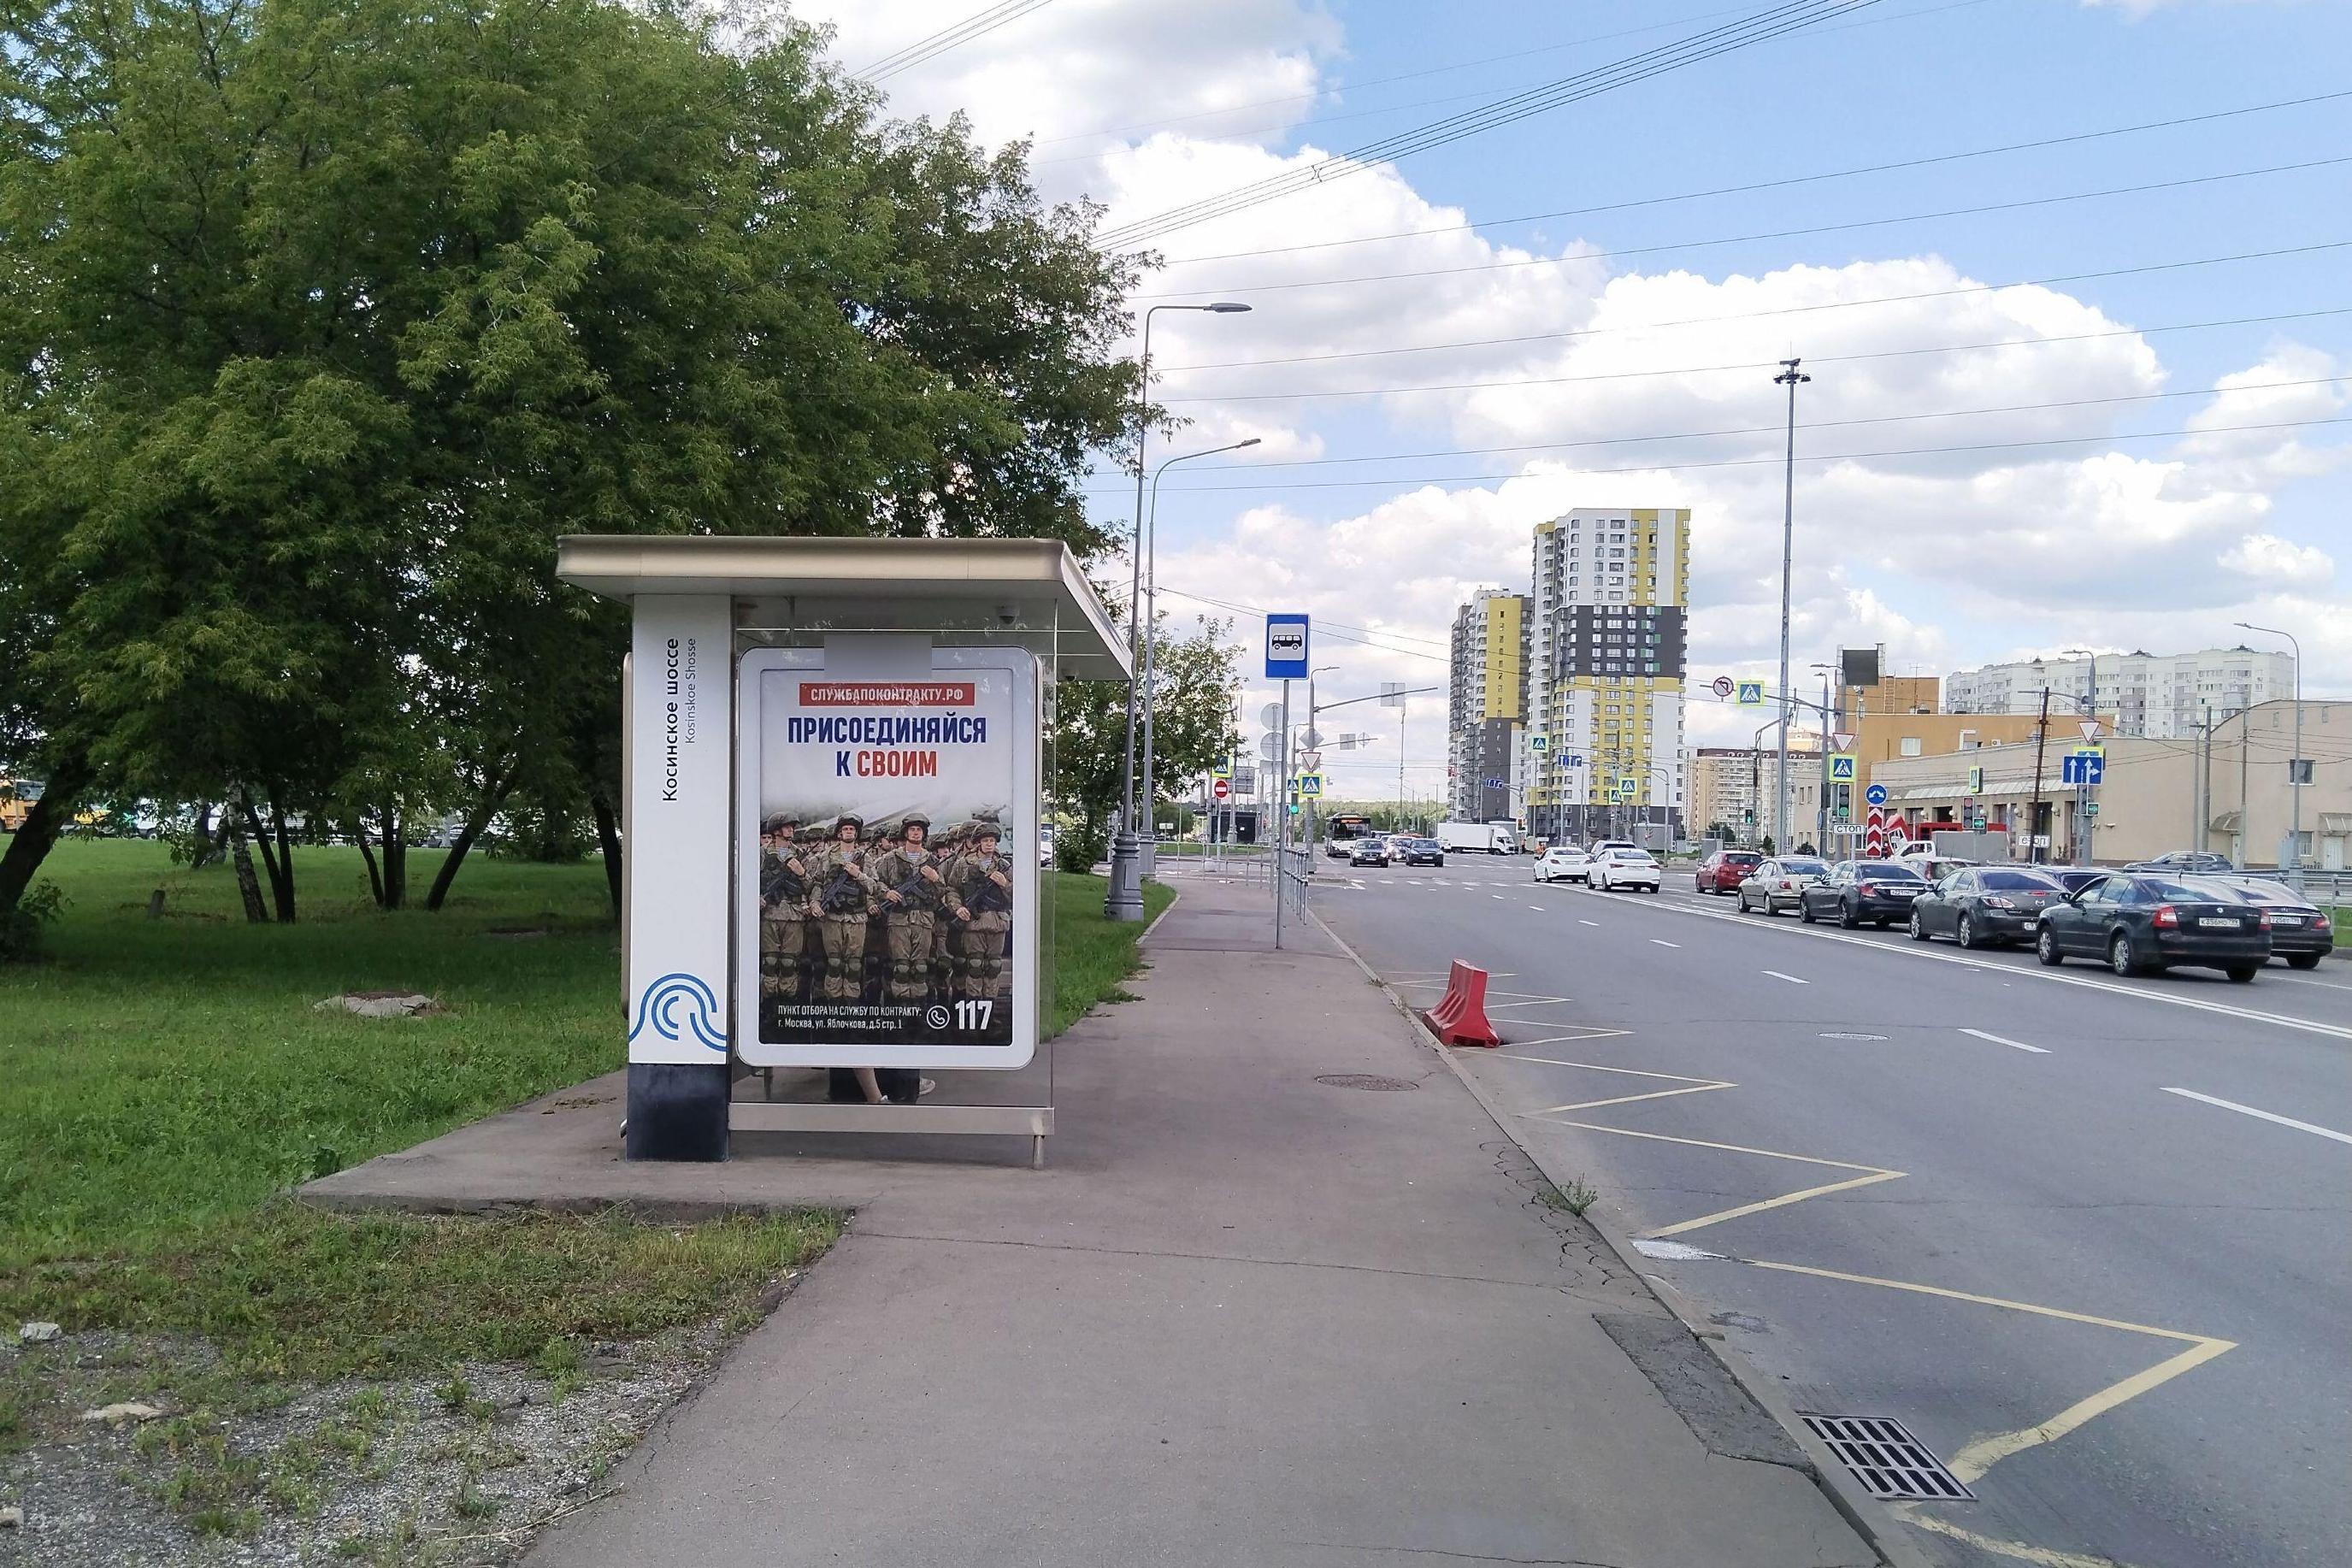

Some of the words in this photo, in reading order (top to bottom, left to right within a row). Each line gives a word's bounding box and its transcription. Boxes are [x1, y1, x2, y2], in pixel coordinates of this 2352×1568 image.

[667, 638, 679, 695] шоссе
[685, 638, 696, 680] Shosse
[811, 688, 964, 701] СЛУЖБАПОКОНТРАКТУ.РФ
[685, 683, 696, 744] Kosinskoe
[787, 710, 987, 746] ПРИСОЕДИНЯЙСЯ
[663, 702, 678, 801] Косинское
[836, 751, 851, 776] К
[857, 751, 937, 777] СВОИМ
[2021, 837, 2046, 846] СОП
[778, 1005, 800, 1016] ПУНКТ
[802, 1005, 828, 1016] ОТБОРА
[829, 1005, 838, 1016] НА
[840, 1005, 868, 1017] СЛУЖБУ
[869, 1006, 879, 1016] ПО
[881, 1006, 922, 1017] КОНТРАКТУ:
[778, 1019, 783, 1028] г.
[785, 1017, 814, 1029] Москва,
[815, 1019, 826, 1029] ул.
[881, 1020, 896, 1030] стр.
[898, 1018, 902, 1029] 1
[954, 999, 993, 1030] 117
